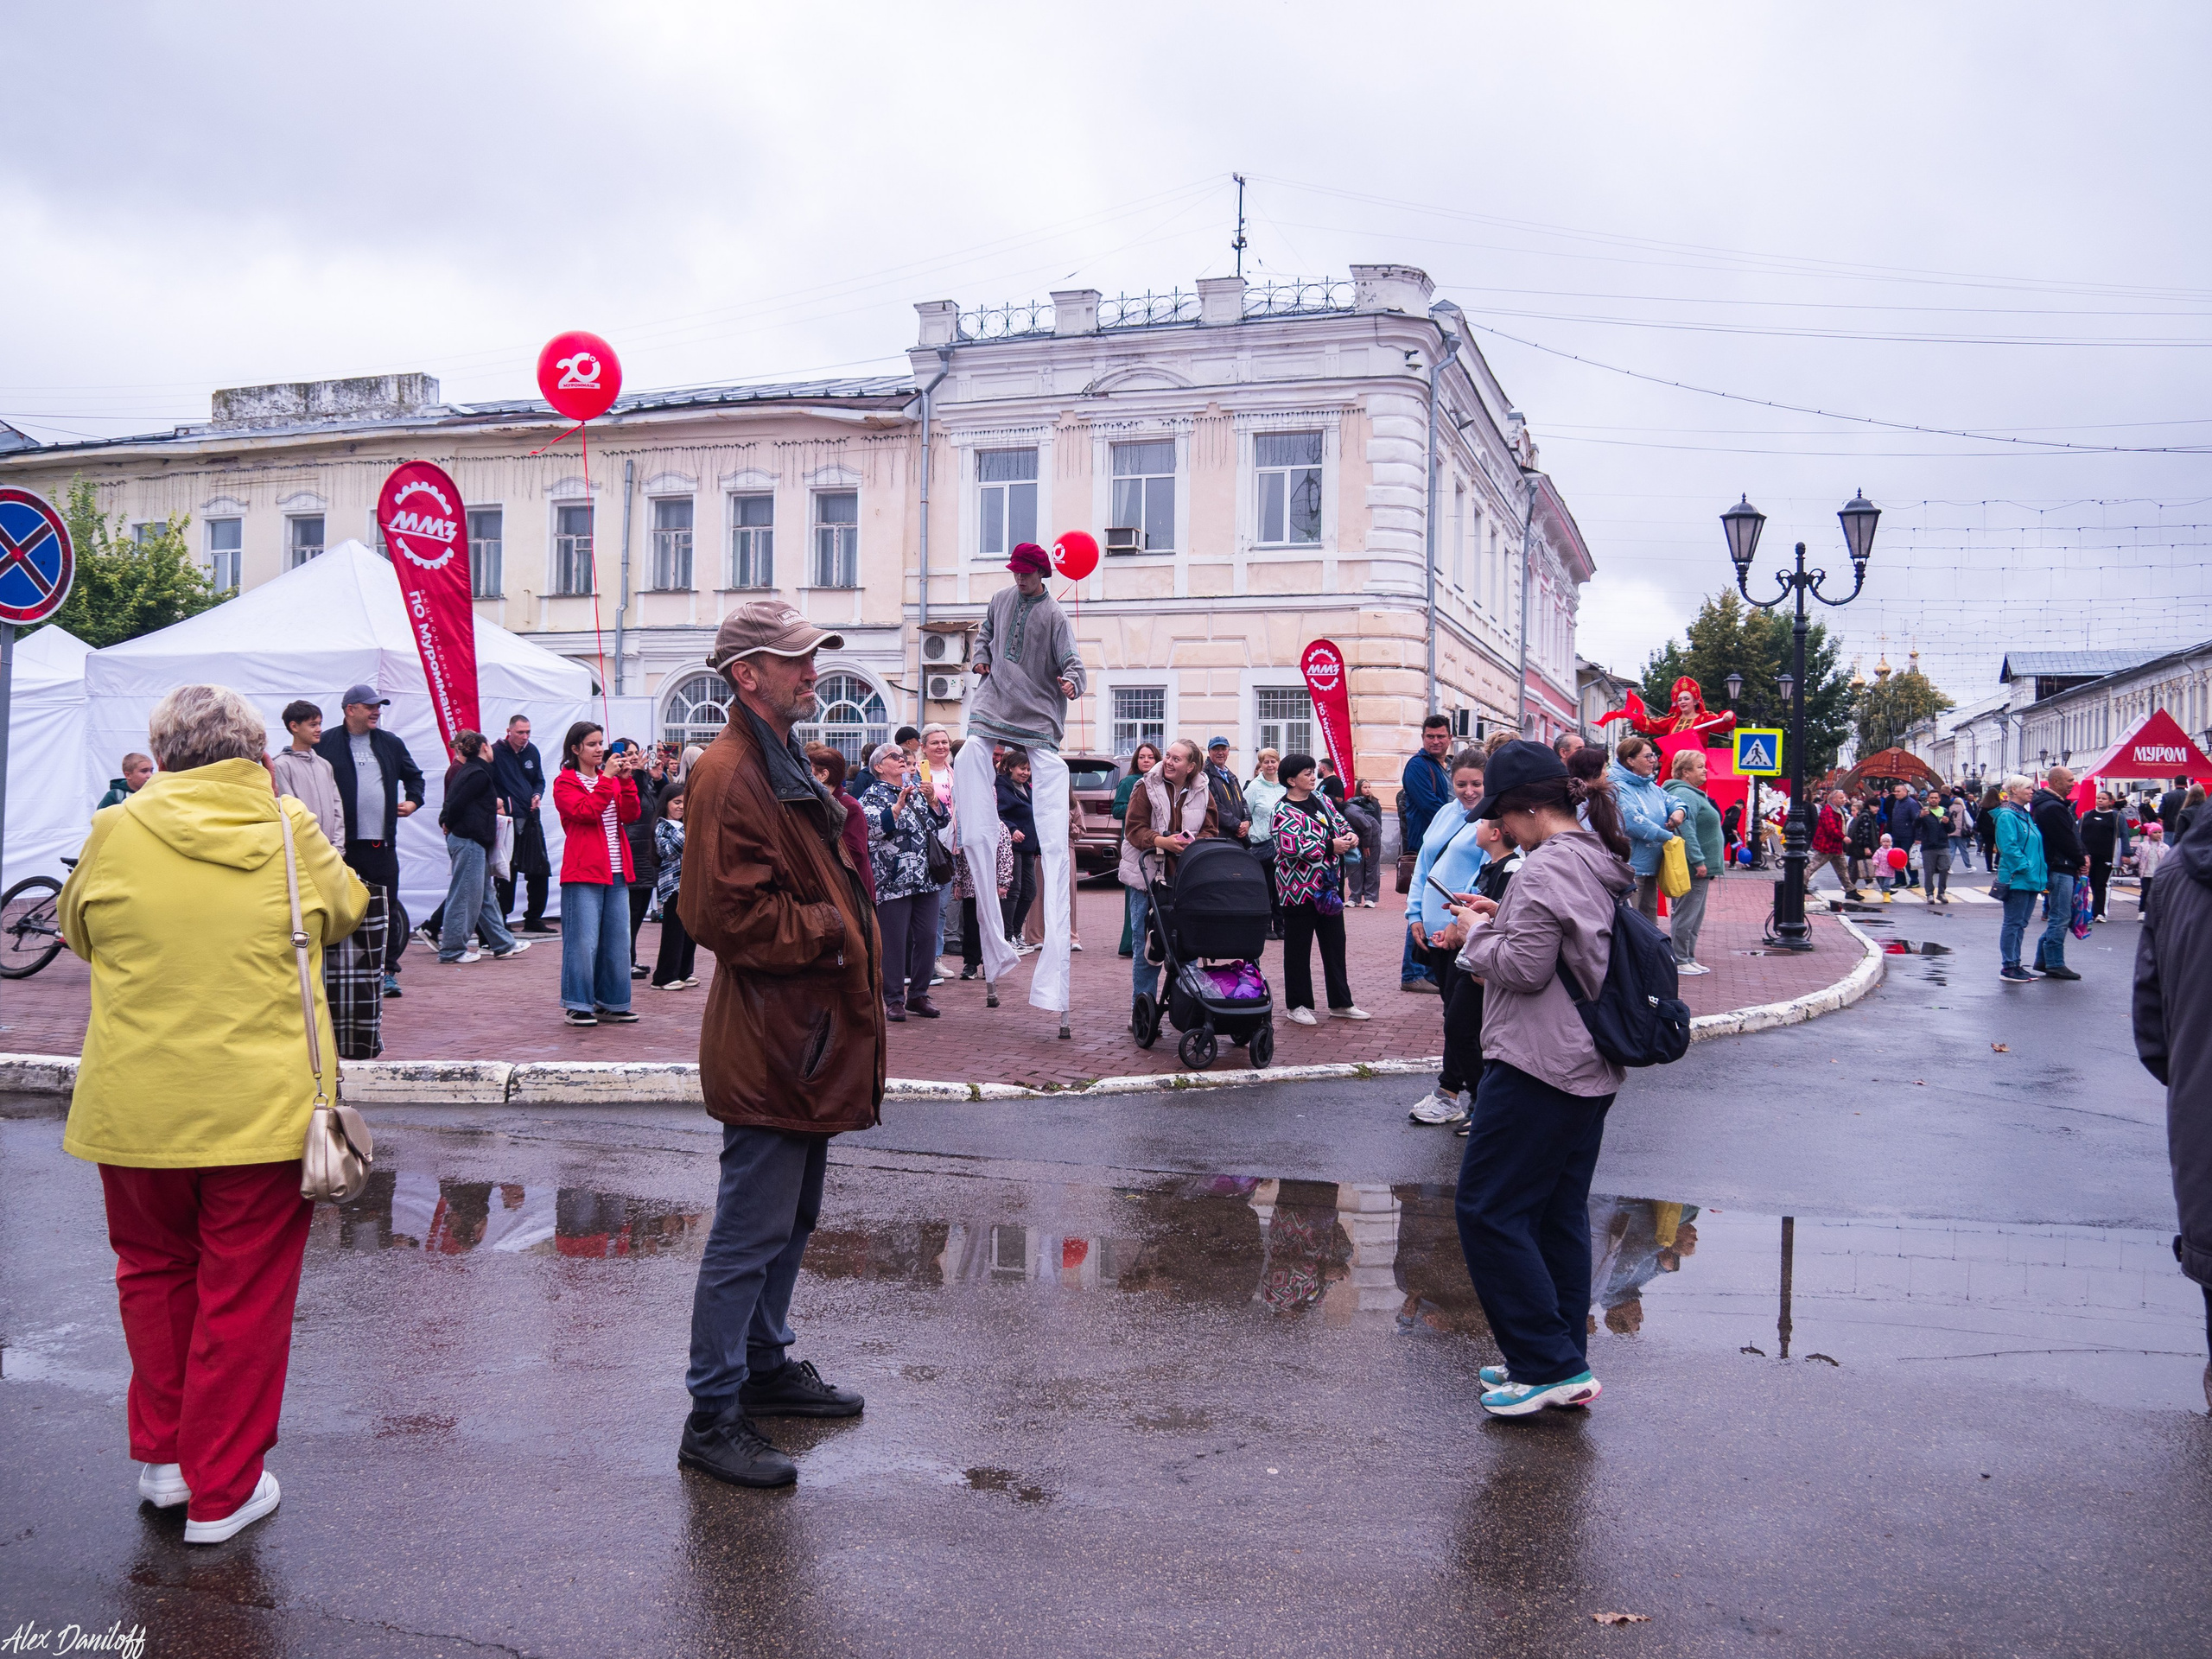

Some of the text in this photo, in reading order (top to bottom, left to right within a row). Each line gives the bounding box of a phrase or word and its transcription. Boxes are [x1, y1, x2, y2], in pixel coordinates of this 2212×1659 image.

[388, 511, 457, 543] ММЗ
[409, 590, 459, 741] ПО Муроммашза
[420, 588, 453, 688] акционерное
[1306, 664, 1340, 676] ММЗ
[1317, 702, 1348, 789] ПО Муроммашзавод
[2133, 746, 2187, 762] МУРОМ
